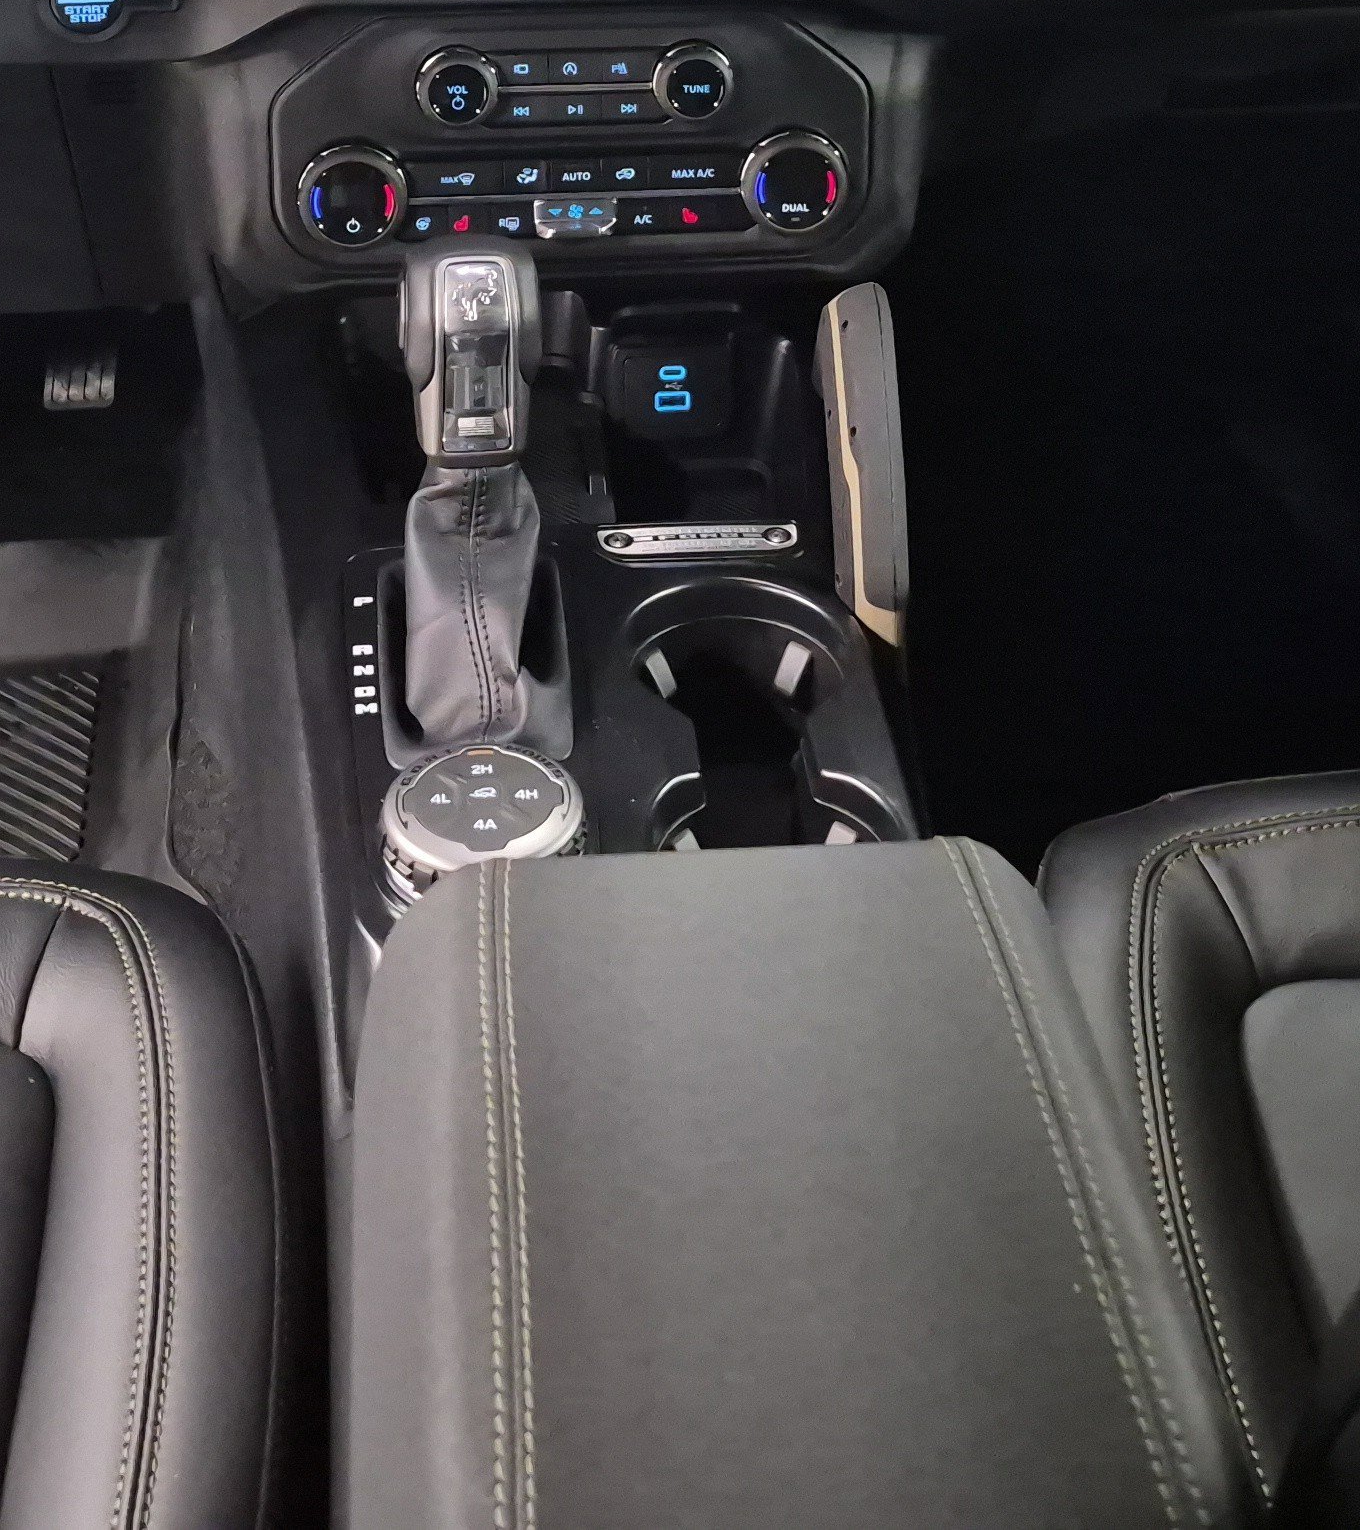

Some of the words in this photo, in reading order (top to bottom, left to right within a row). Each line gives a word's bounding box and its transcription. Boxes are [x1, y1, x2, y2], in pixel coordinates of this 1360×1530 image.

[64, 4, 110, 15] START
[69, 13, 107, 24] STOP
[446, 85, 469, 95] VOL
[683, 84, 711, 95] TUNE
[562, 172, 591, 182] AUTO
[671, 169, 695, 179] MAX
[697, 168, 715, 178] A/C
[440, 175, 458, 184] MAX
[781, 203, 810, 213] DUAL
[634, 214, 653, 225] A/C
[353, 664, 375, 676] N
[354, 702, 378, 715] M
[471, 763, 494, 775] 2H
[429, 792, 452, 805] 4L
[514, 788, 539, 801] 4H
[472, 818, 499, 831] 4A
